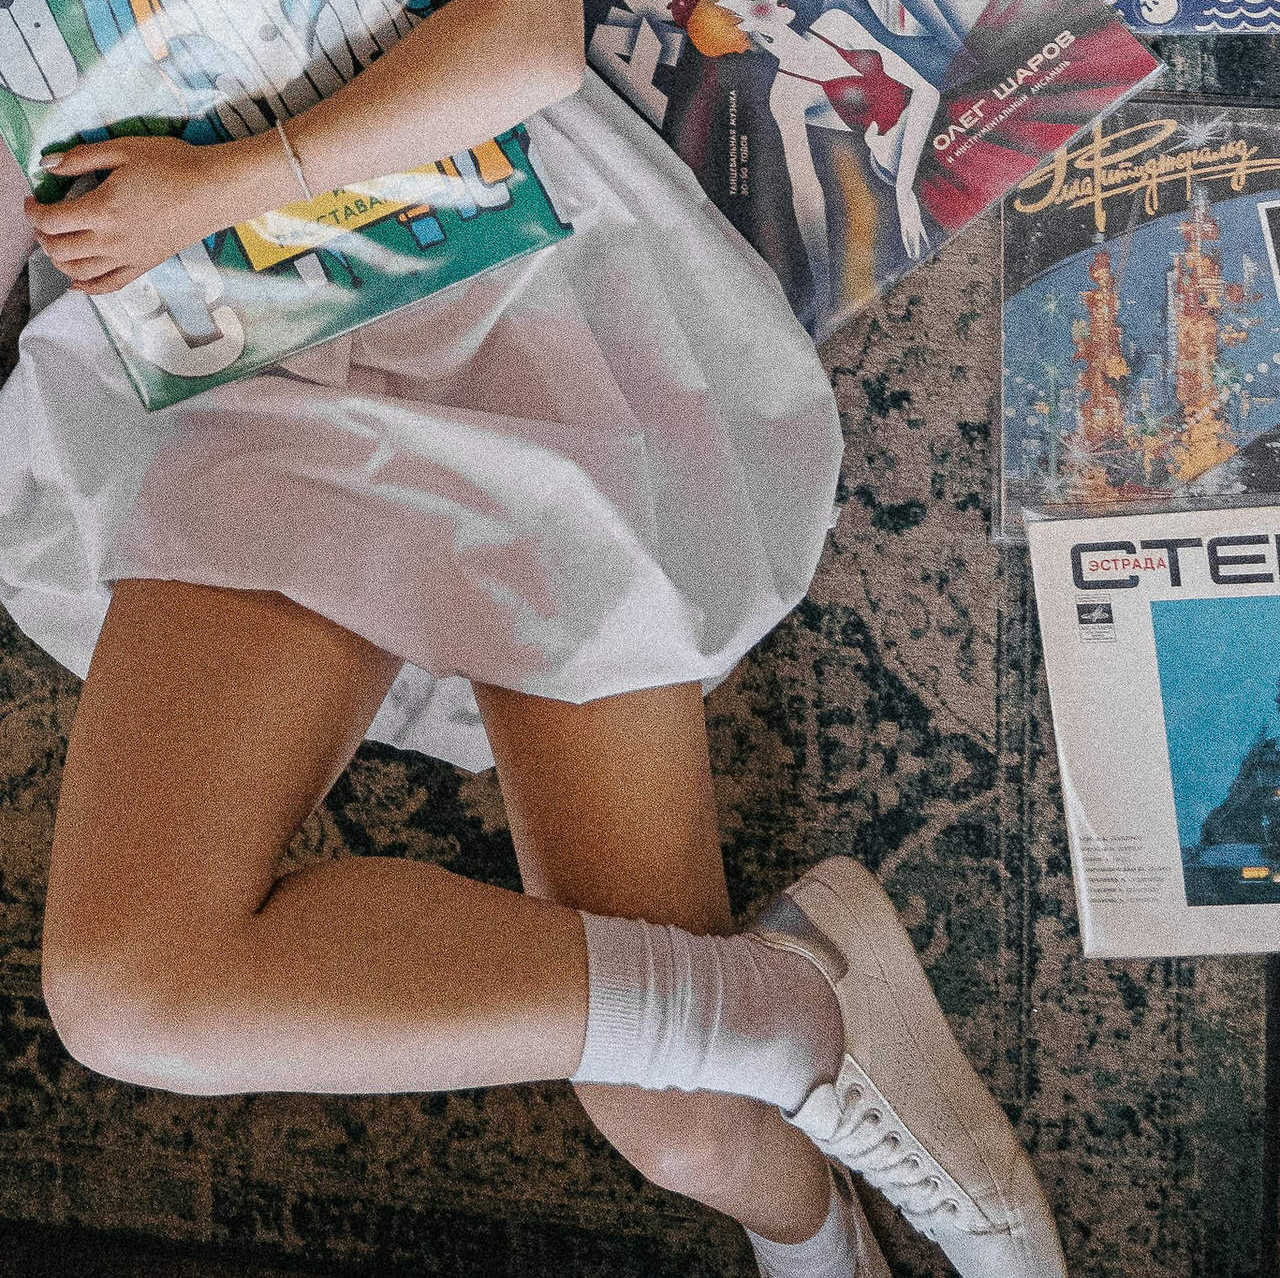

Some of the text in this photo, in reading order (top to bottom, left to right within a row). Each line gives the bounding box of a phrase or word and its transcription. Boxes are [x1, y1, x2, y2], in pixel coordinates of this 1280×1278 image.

[930, 27, 1078, 154] ОЛЕГ ШАРОВ
[1070, 533, 1280, 591] СТЕ
[1088, 553, 1168, 574] ЭСТРАДА
